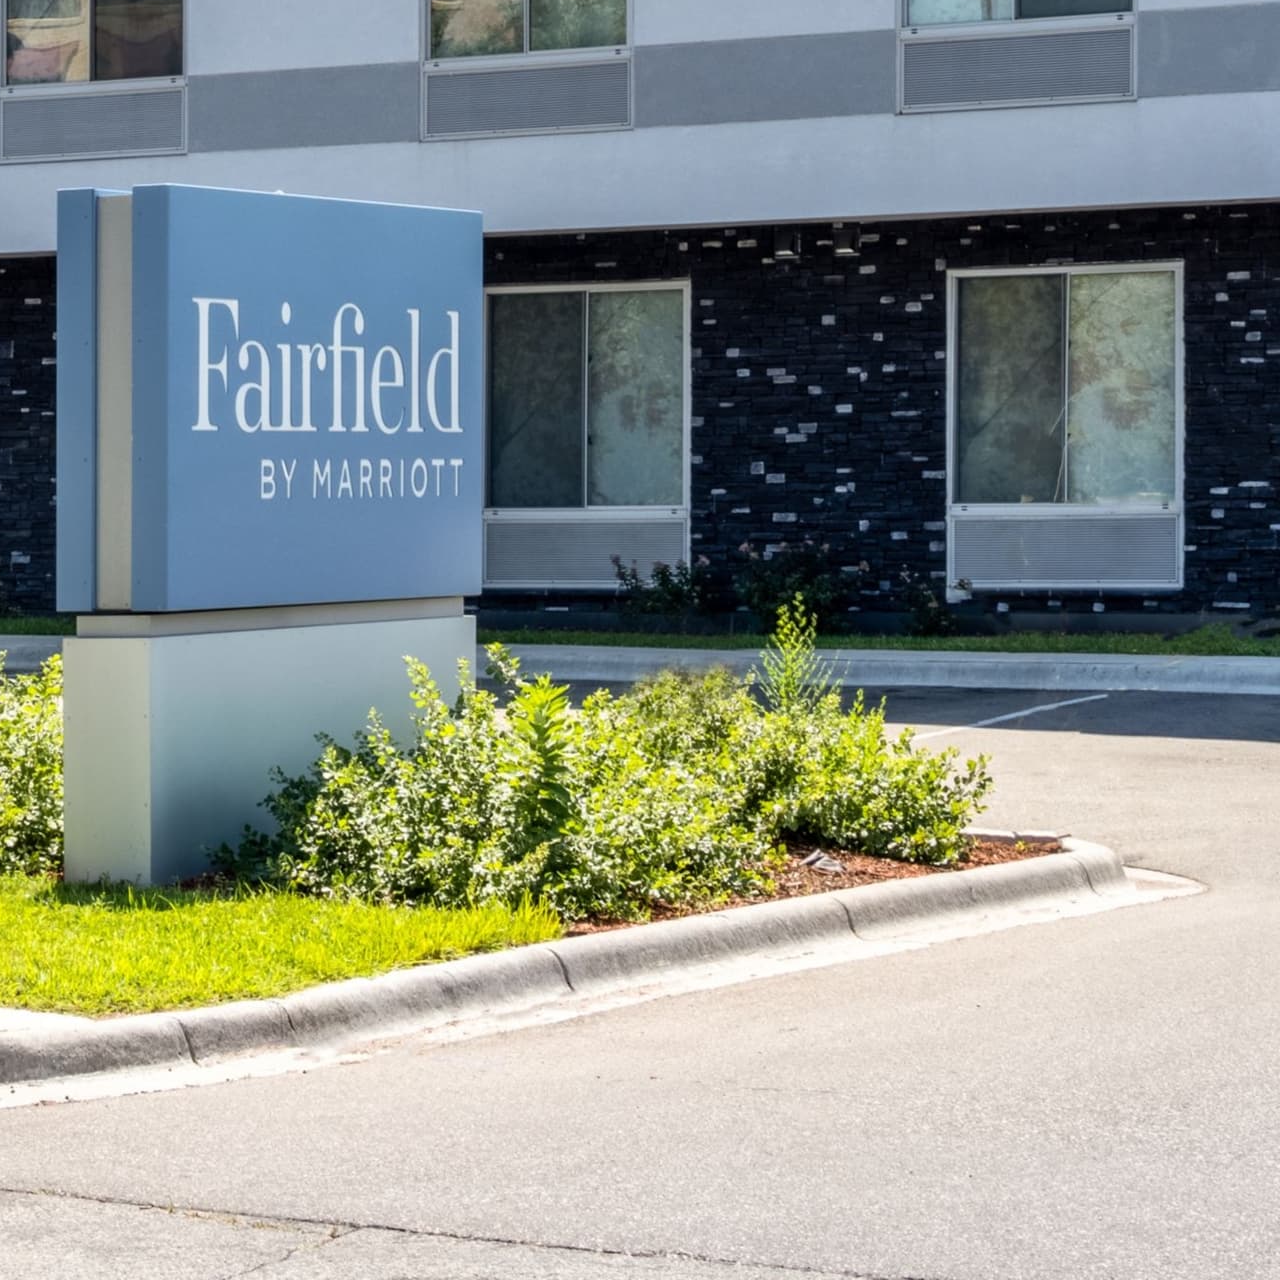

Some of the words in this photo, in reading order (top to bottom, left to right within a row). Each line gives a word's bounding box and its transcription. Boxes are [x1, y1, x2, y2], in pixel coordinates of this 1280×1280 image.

[192, 297, 463, 434] Fairfield
[260, 459, 297, 500] BY
[313, 458, 463, 499] MARRIOTT
